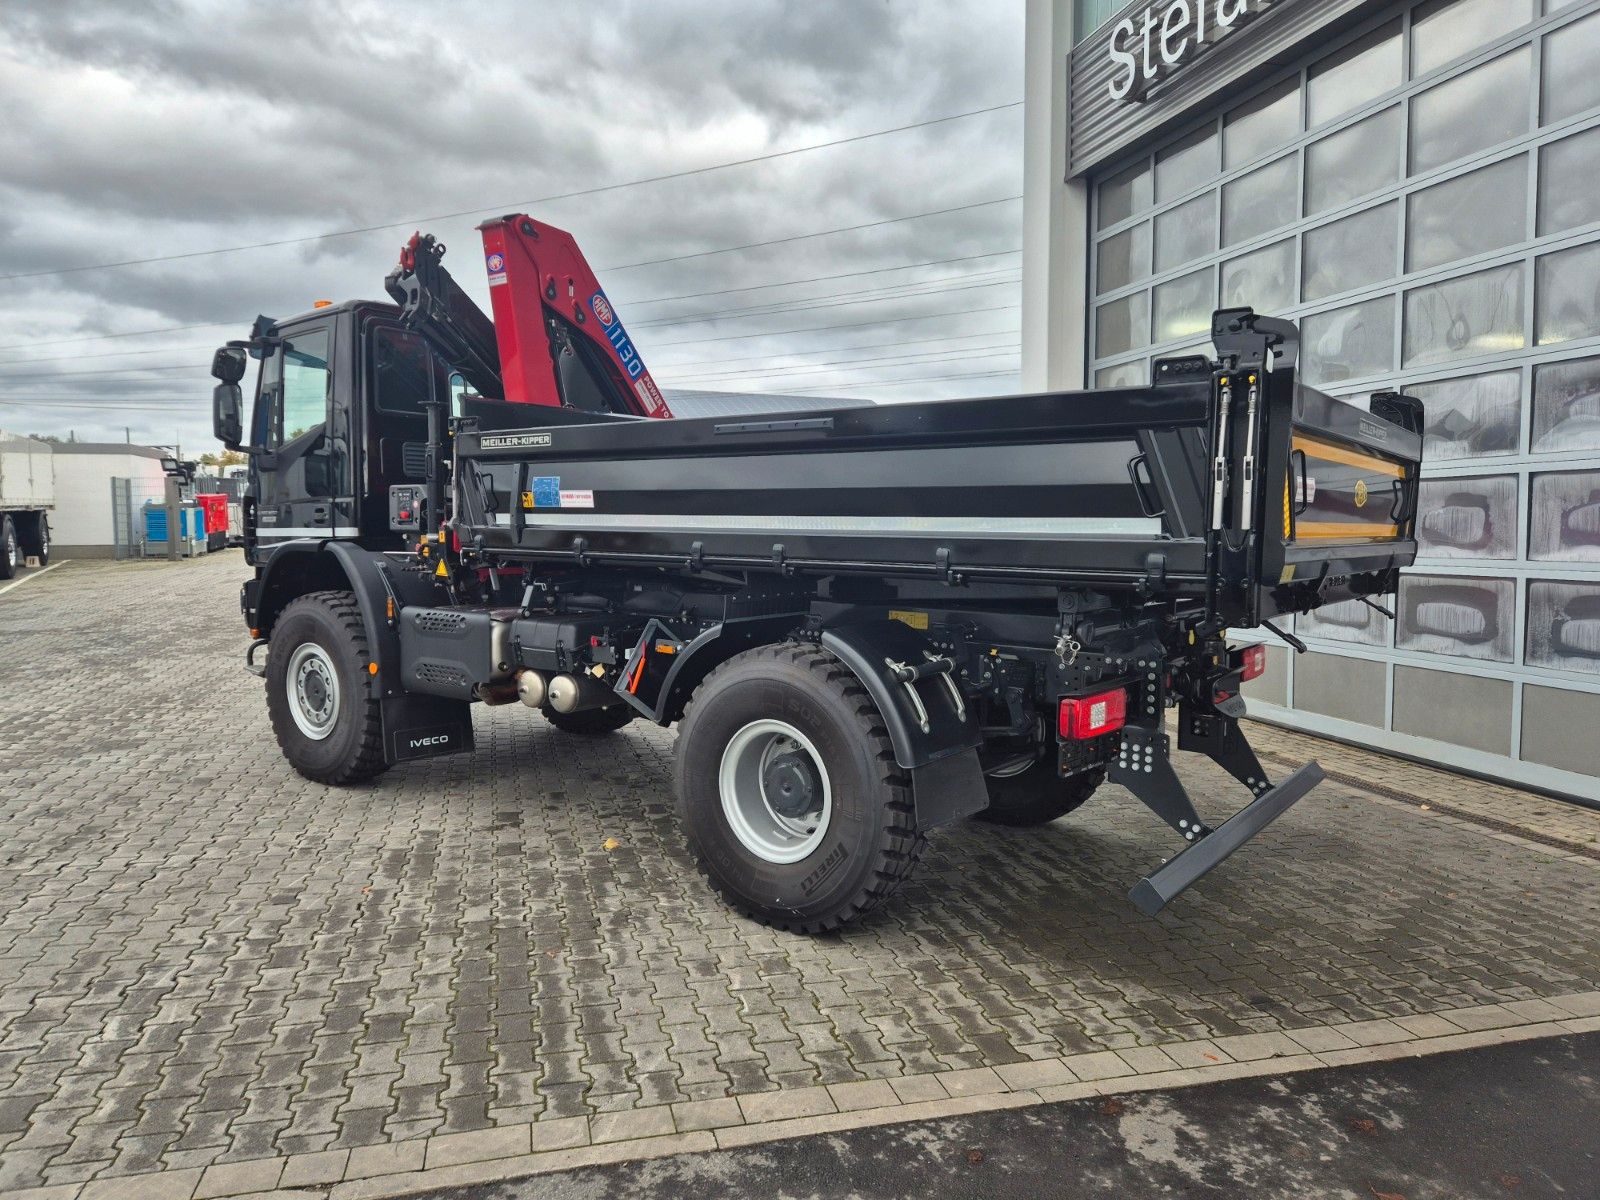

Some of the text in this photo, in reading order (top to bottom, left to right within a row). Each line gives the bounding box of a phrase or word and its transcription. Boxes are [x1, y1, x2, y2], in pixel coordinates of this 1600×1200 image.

[610, 327, 642, 377] 1130
[644, 375, 663, 406] POWER
[482, 435, 550, 447] MEILLER-KIPPER
[410, 735, 449, 748] IVECO
[801, 841, 850, 898] PIRELLI
